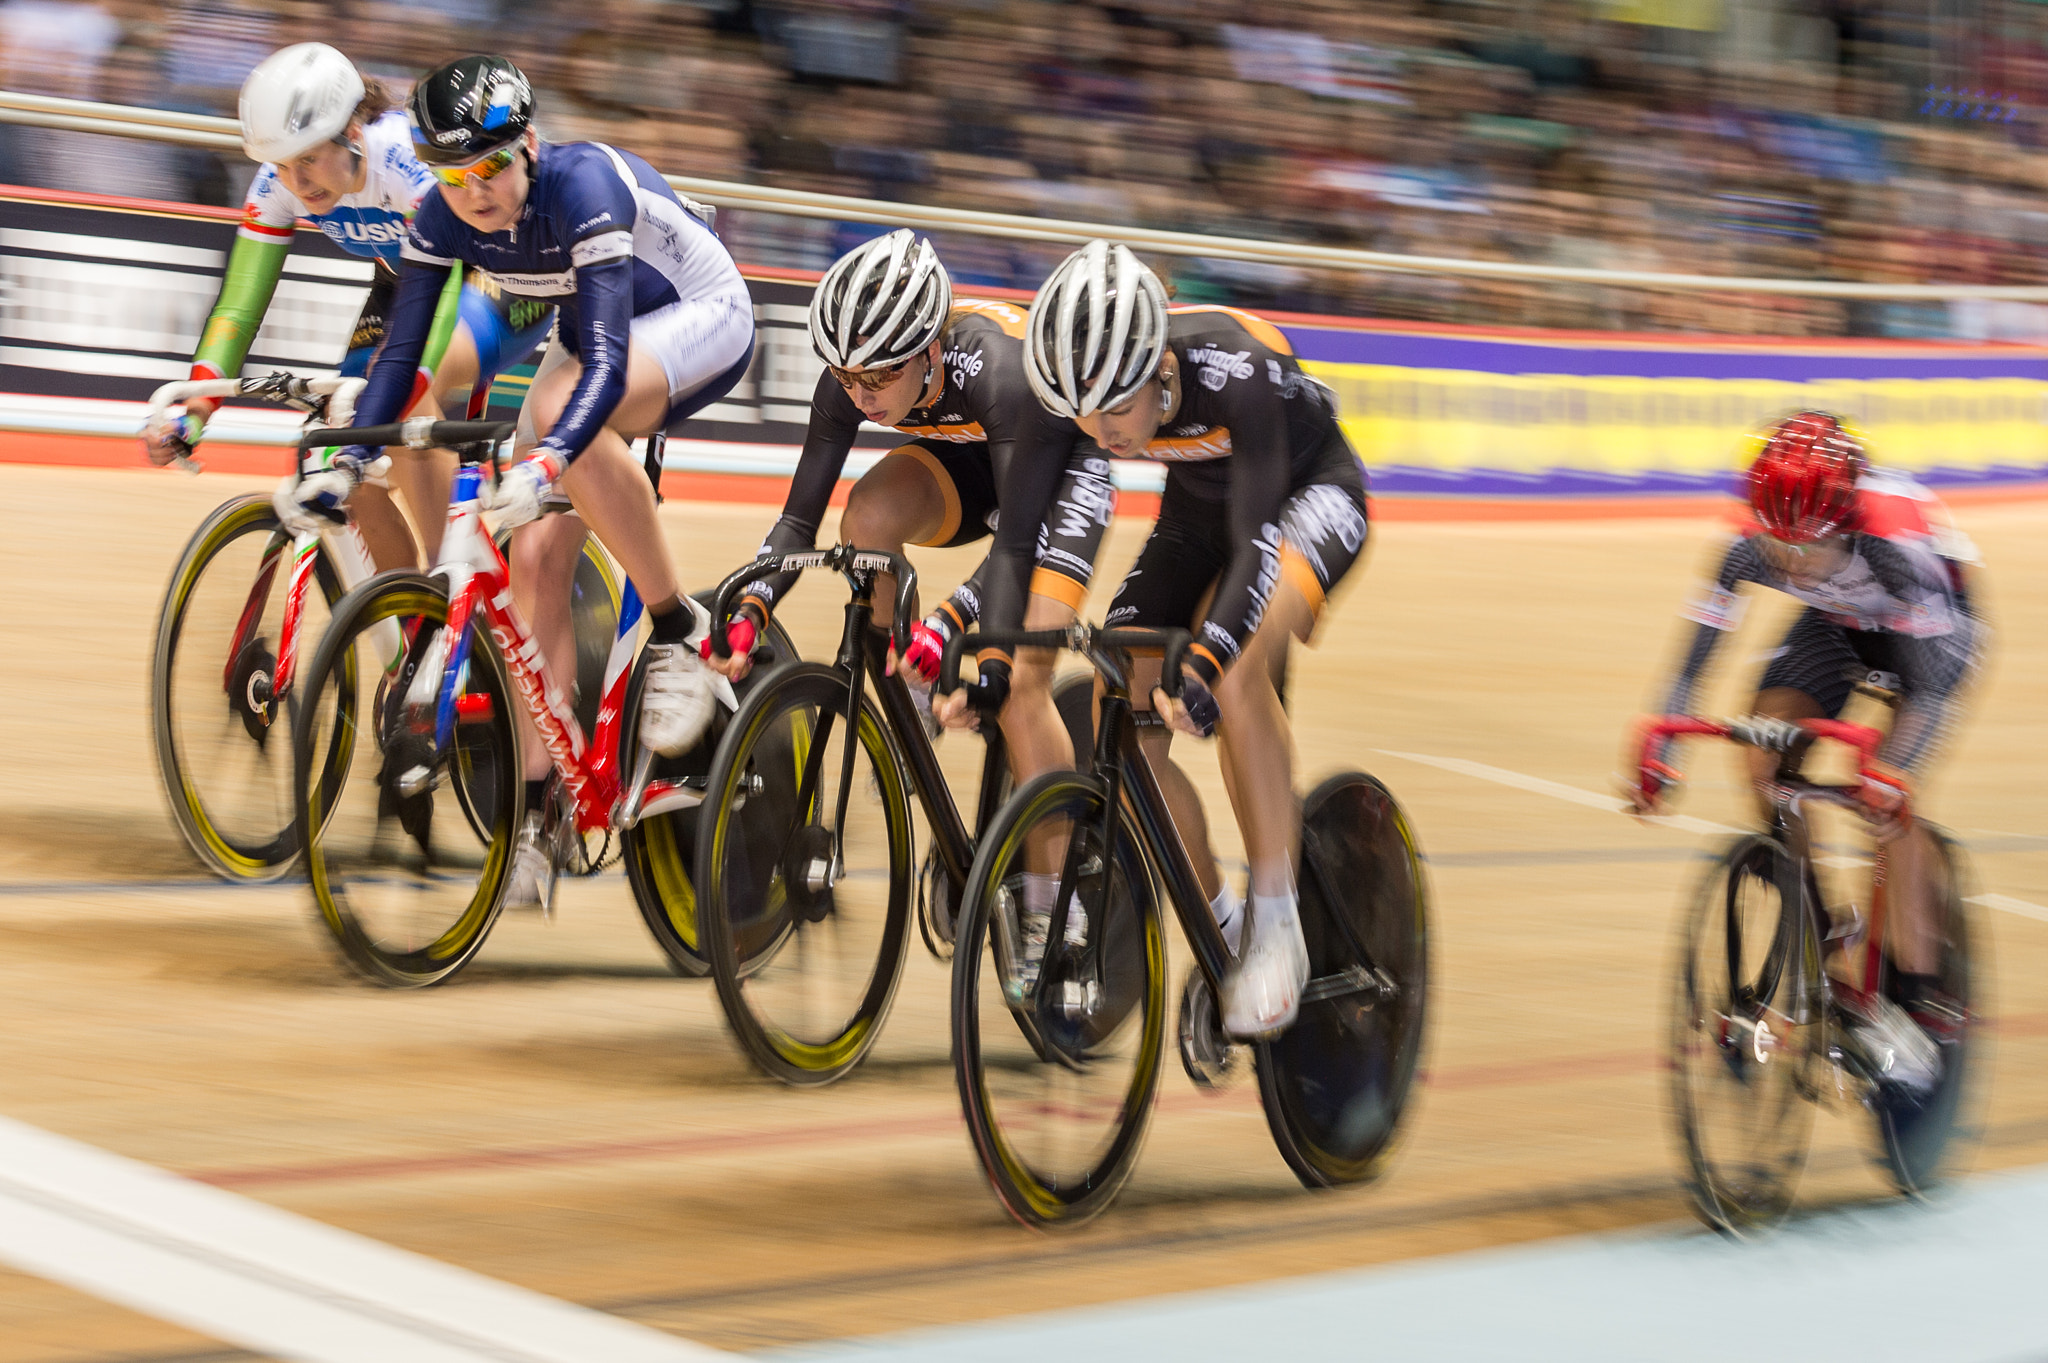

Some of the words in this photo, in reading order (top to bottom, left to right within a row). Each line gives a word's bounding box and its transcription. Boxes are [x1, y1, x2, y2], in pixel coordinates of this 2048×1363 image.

[343, 219, 410, 242] USN
[780, 552, 826, 573] ALPINA
[852, 553, 891, 573] ALPINA
